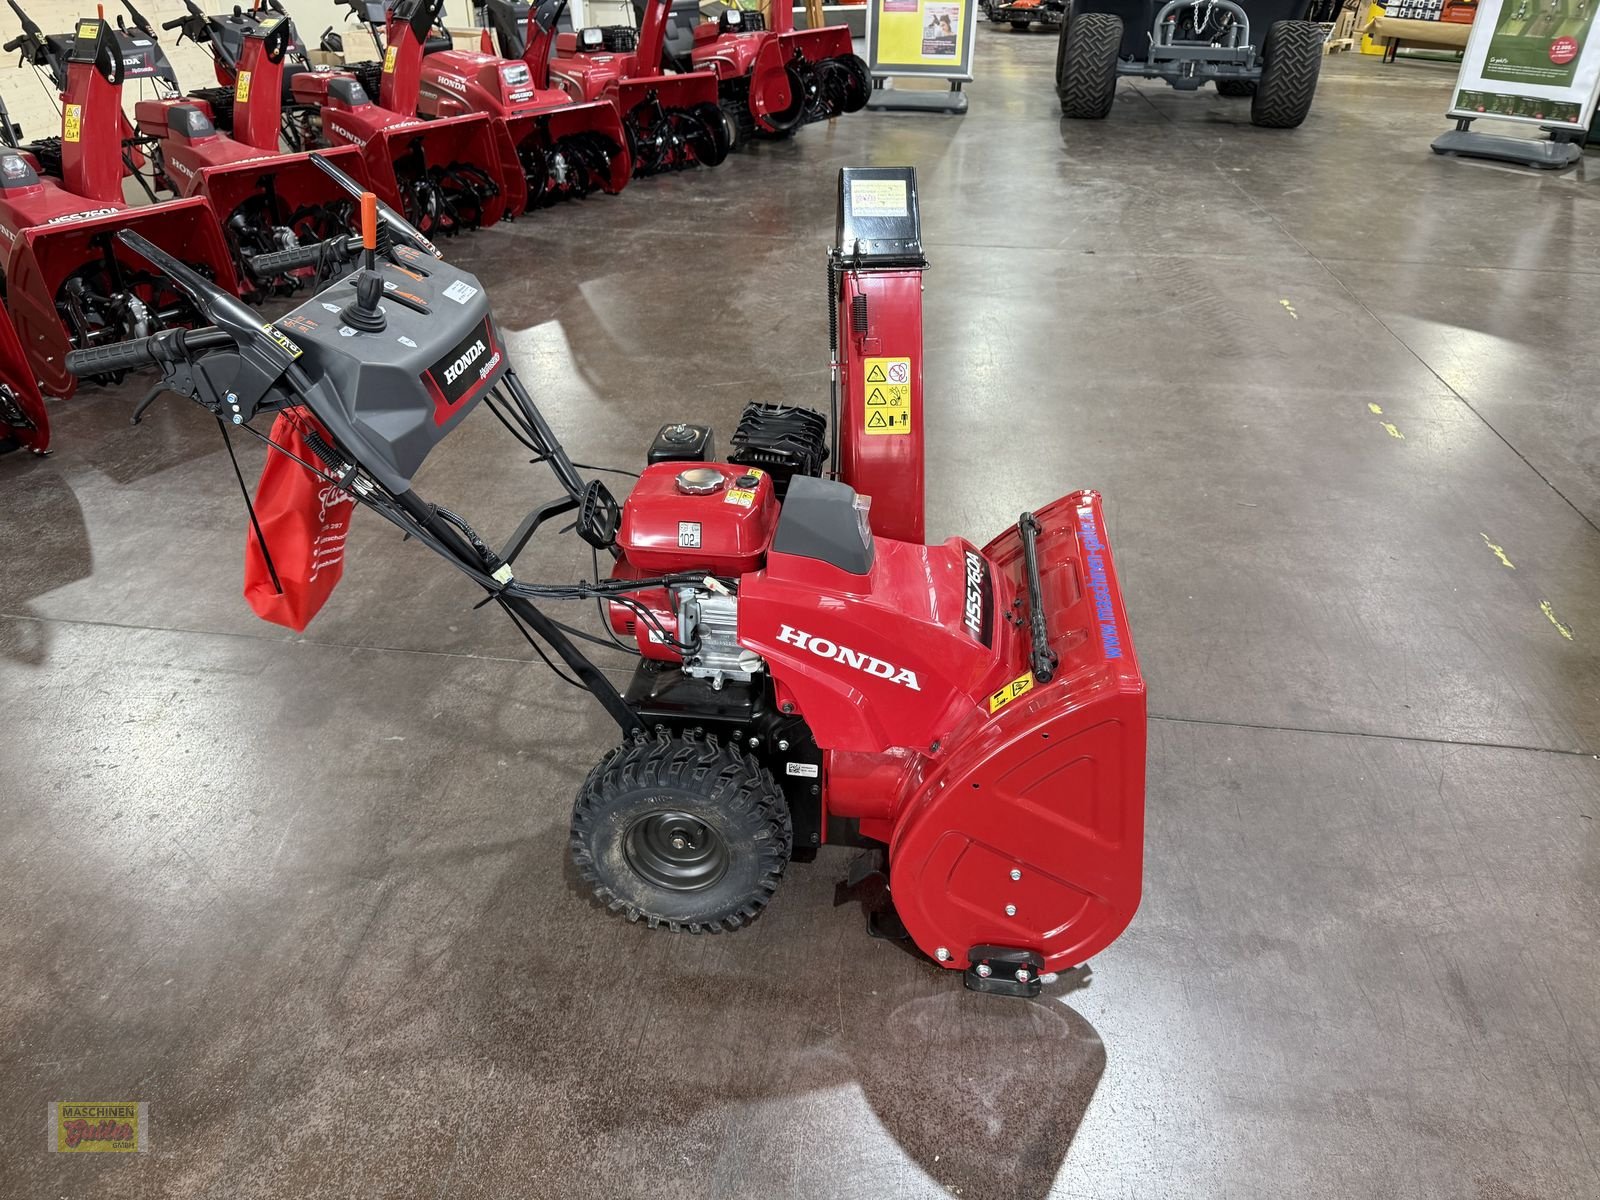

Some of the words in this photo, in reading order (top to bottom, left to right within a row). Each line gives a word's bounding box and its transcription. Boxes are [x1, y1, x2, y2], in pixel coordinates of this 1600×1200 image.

[437, 75, 467, 92] HONDA
[171, 157, 194, 178] HON
[443, 339, 487, 386] HONDA
[680, 533, 695, 546] 102
[965, 551, 981, 632] HSS760A
[775, 624, 921, 692] HONDA
